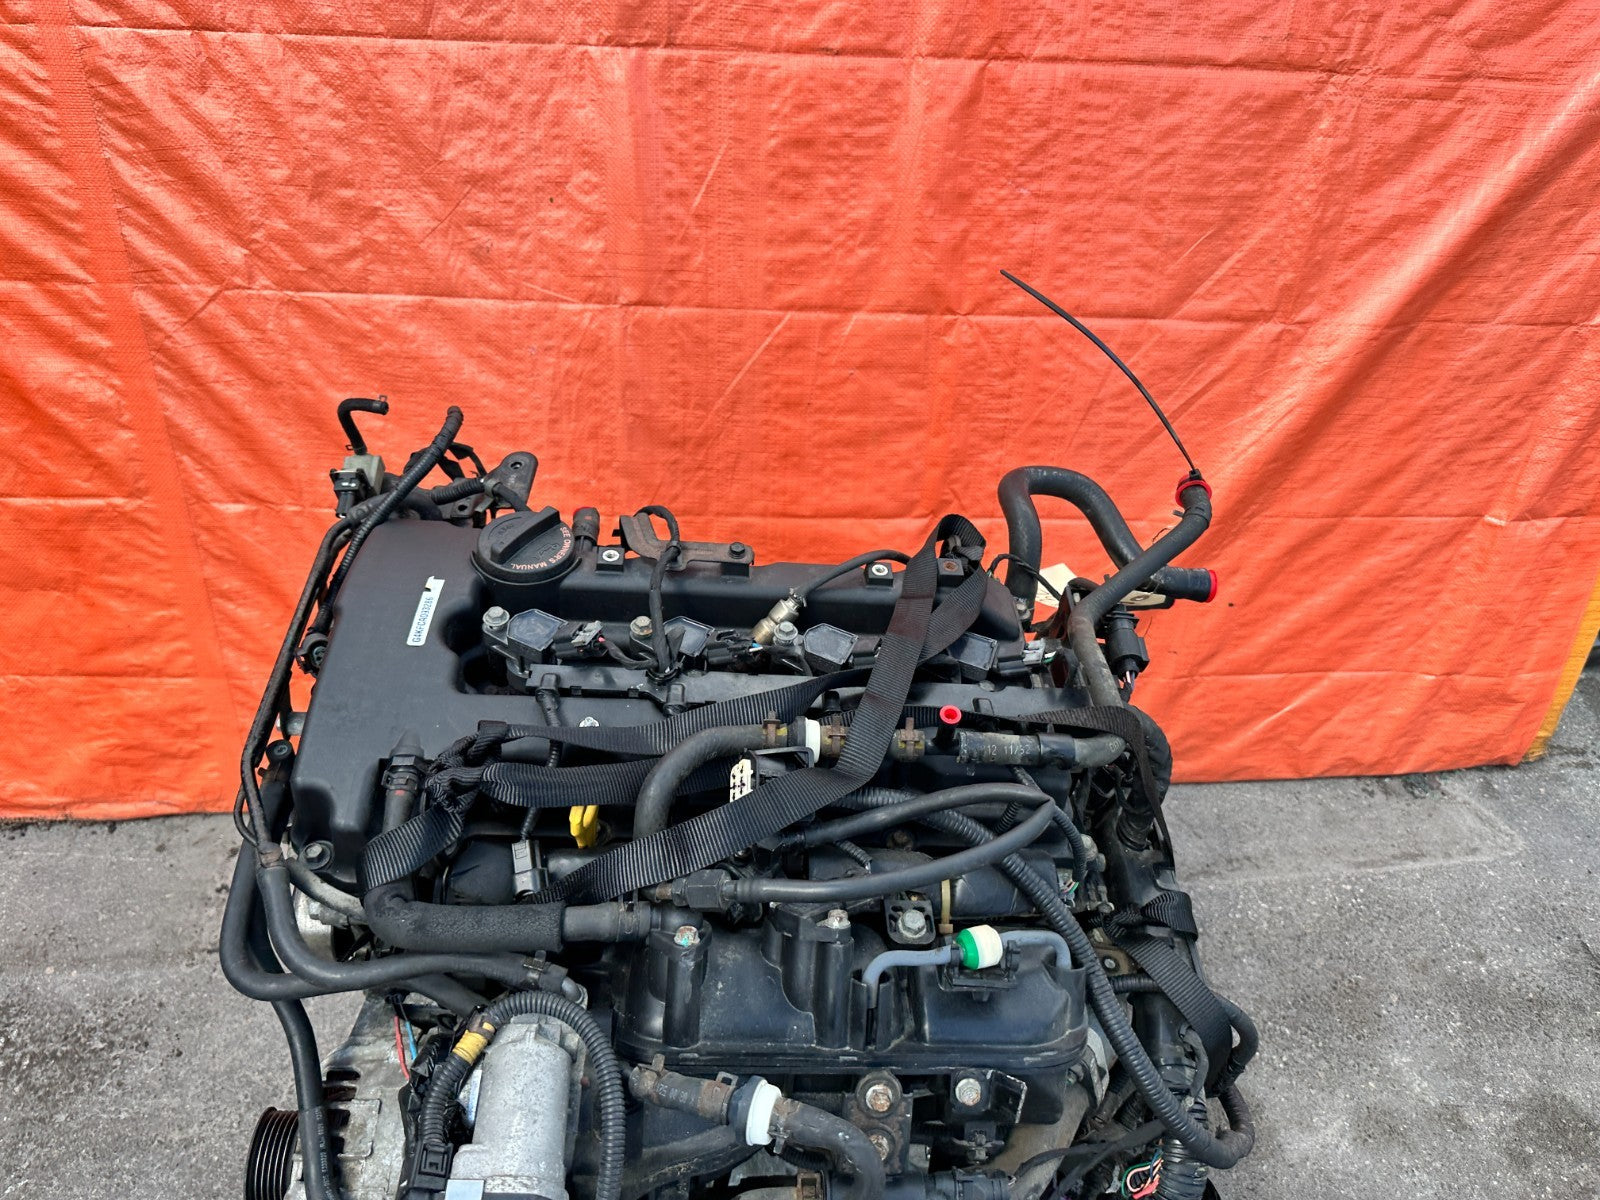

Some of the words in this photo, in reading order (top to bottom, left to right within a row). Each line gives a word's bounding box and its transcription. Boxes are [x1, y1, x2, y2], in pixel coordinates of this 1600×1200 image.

[560, 526, 571, 538] SEE
[548, 539, 571, 564] OWNER'S
[510, 561, 548, 571] MANUAL
